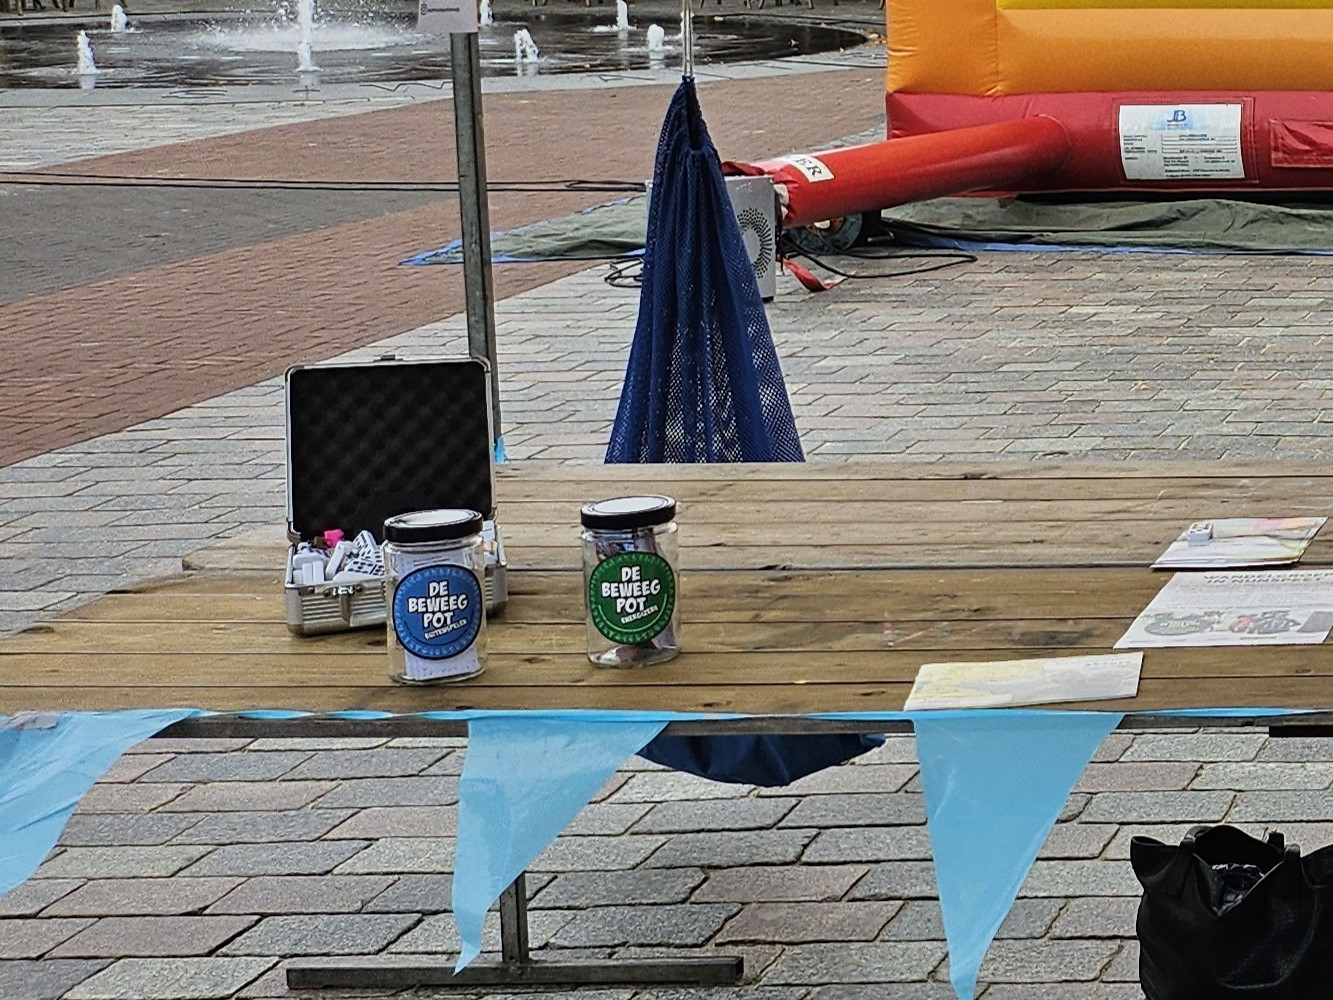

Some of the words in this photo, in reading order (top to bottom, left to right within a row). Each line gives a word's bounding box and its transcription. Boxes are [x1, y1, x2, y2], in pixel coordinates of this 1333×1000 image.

[621, 566, 641, 582] DE
[429, 581, 448, 596] DE
[601, 579, 660, 597] BEWEEG
[408, 594, 469, 613] BEWEEG
[616, 597, 647, 613] POT
[423, 612, 454, 628] POT
